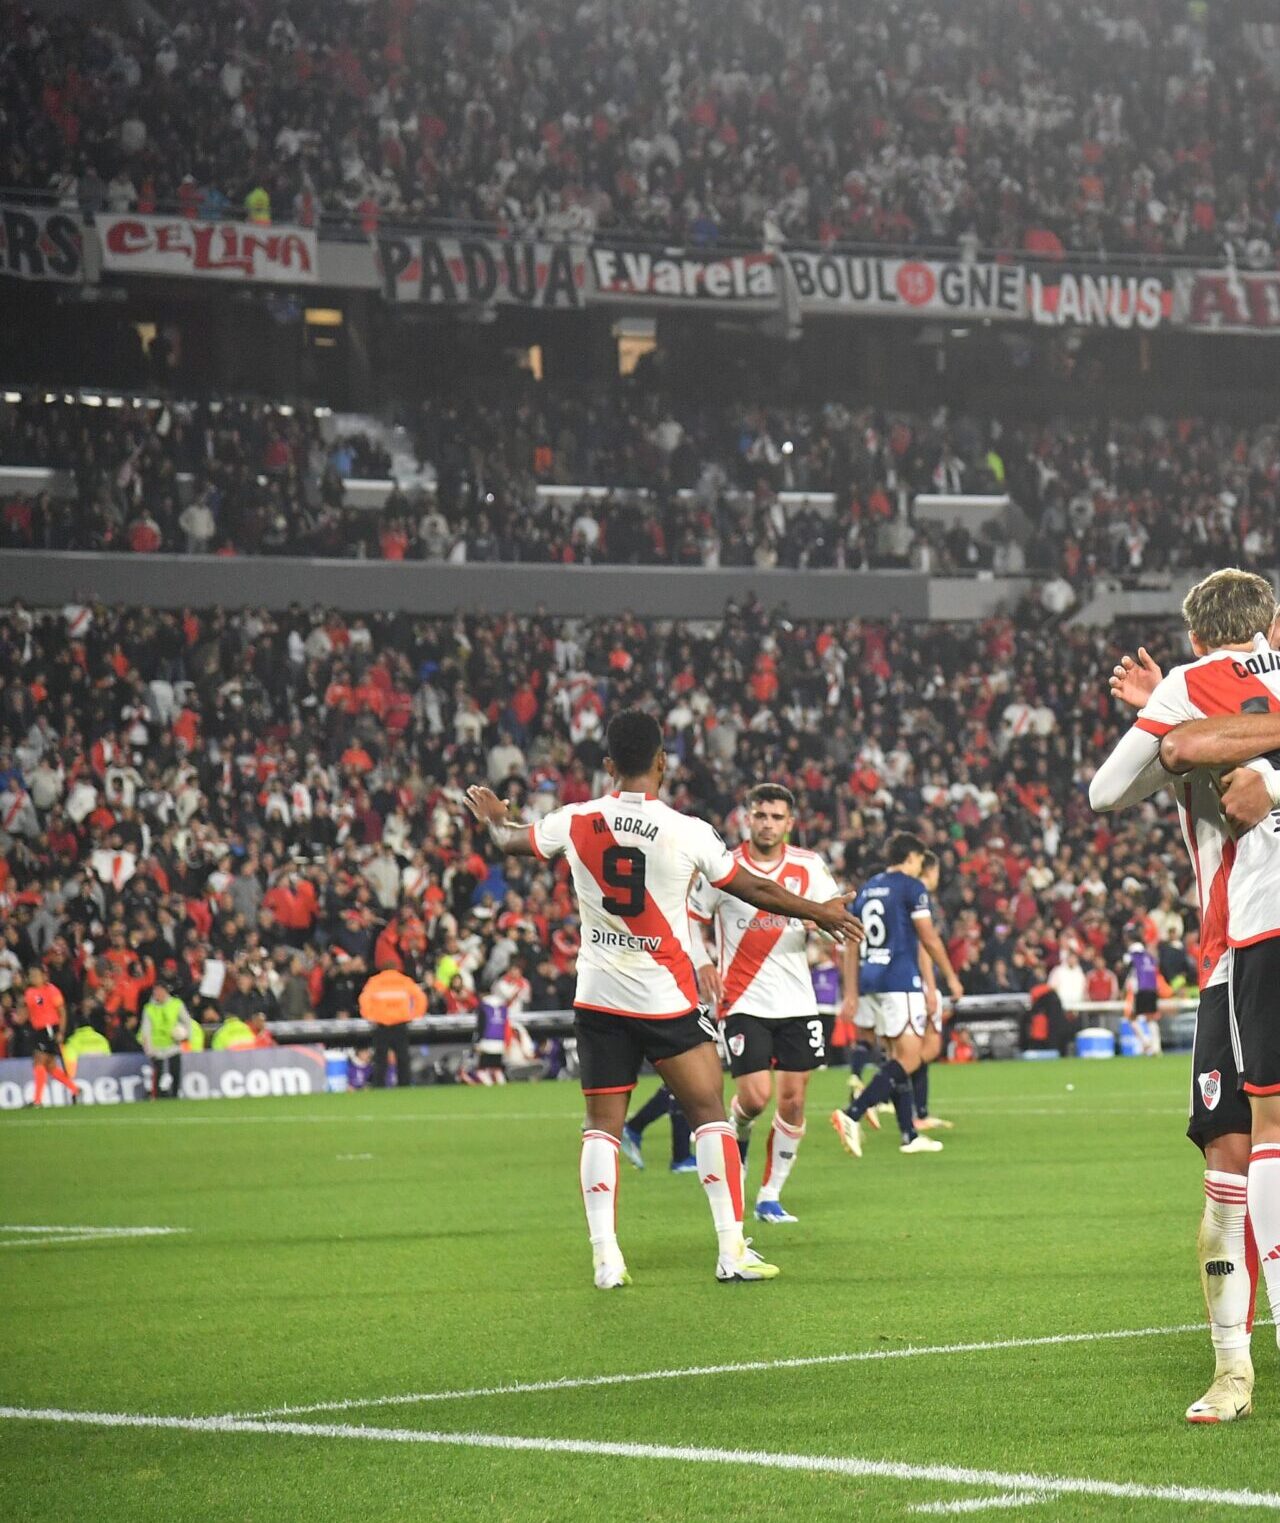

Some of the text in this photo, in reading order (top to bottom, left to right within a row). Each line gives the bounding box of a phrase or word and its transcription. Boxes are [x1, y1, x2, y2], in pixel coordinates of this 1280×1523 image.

[0, 209, 81, 275] RS
[379, 240, 581, 304] PADUA
[1030, 272, 1163, 329] LANUS
[593, 816, 659, 842] M. BORJA
[602, 845, 646, 918] 9
[592, 929, 662, 951] DIRECTV
[807, 1019, 824, 1049] 3
